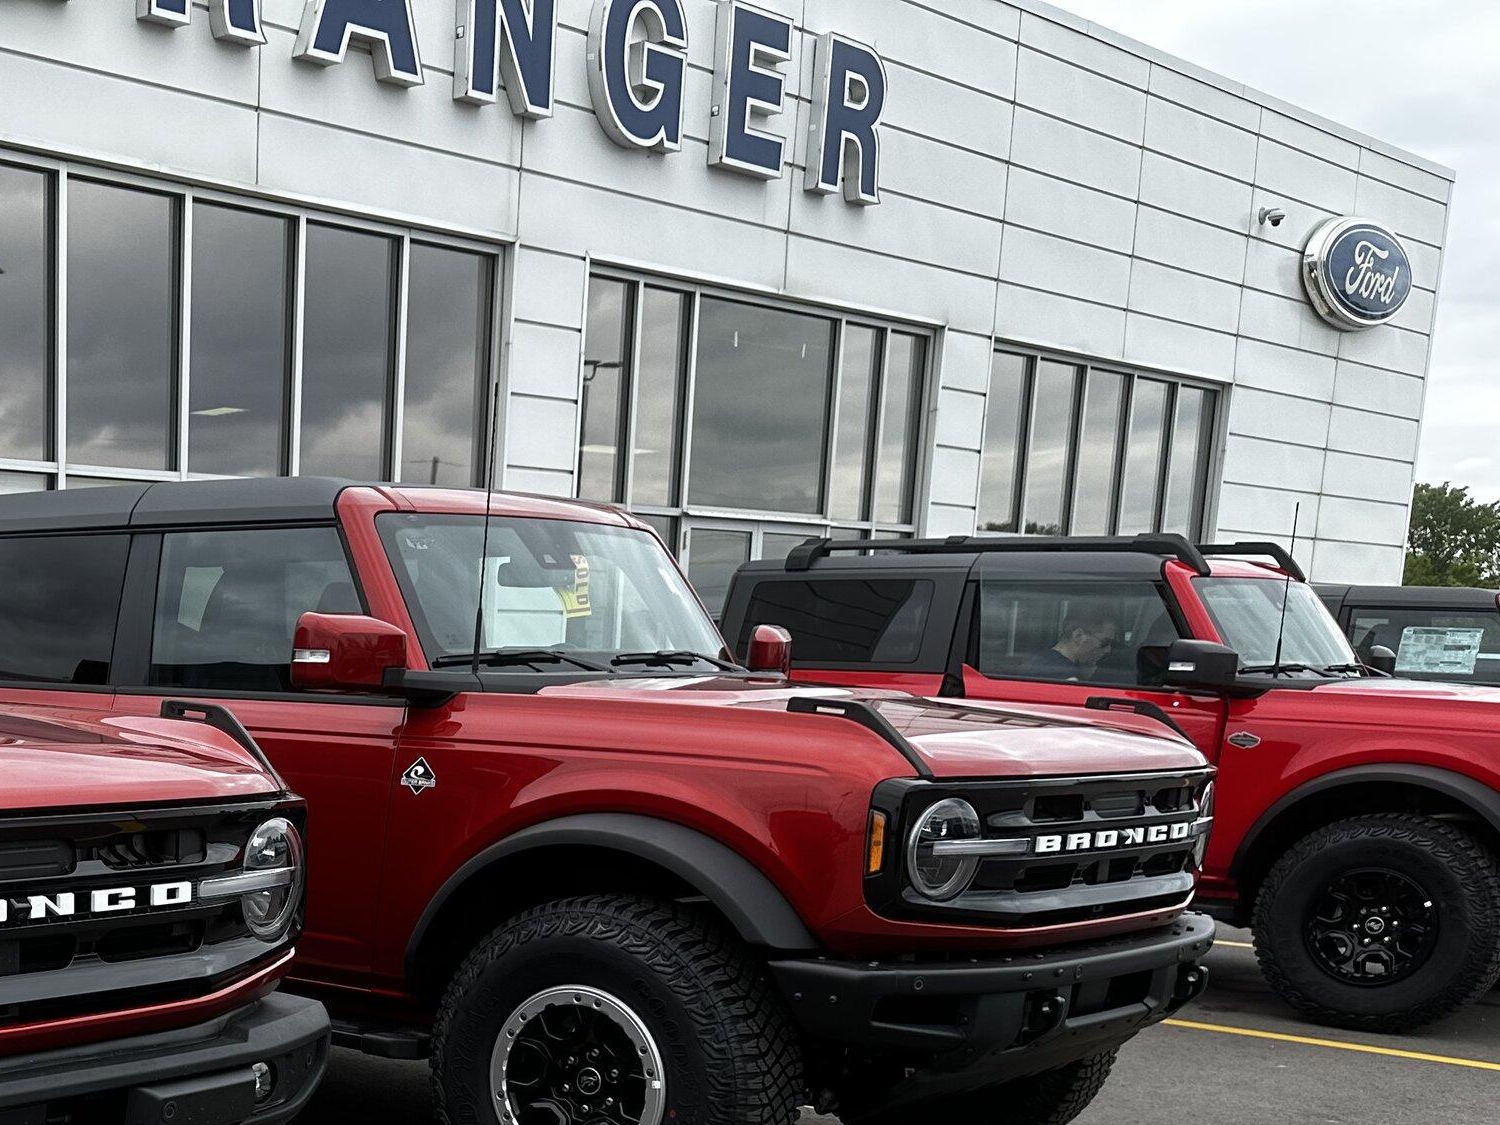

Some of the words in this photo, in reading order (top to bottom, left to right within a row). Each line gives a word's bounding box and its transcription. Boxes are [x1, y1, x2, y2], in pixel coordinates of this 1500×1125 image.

[136, 0, 888, 206] ANGER
[1345, 240, 1399, 304] Ford
[572, 555, 589, 606] SOLD
[1035, 822, 1188, 853] BRONCO
